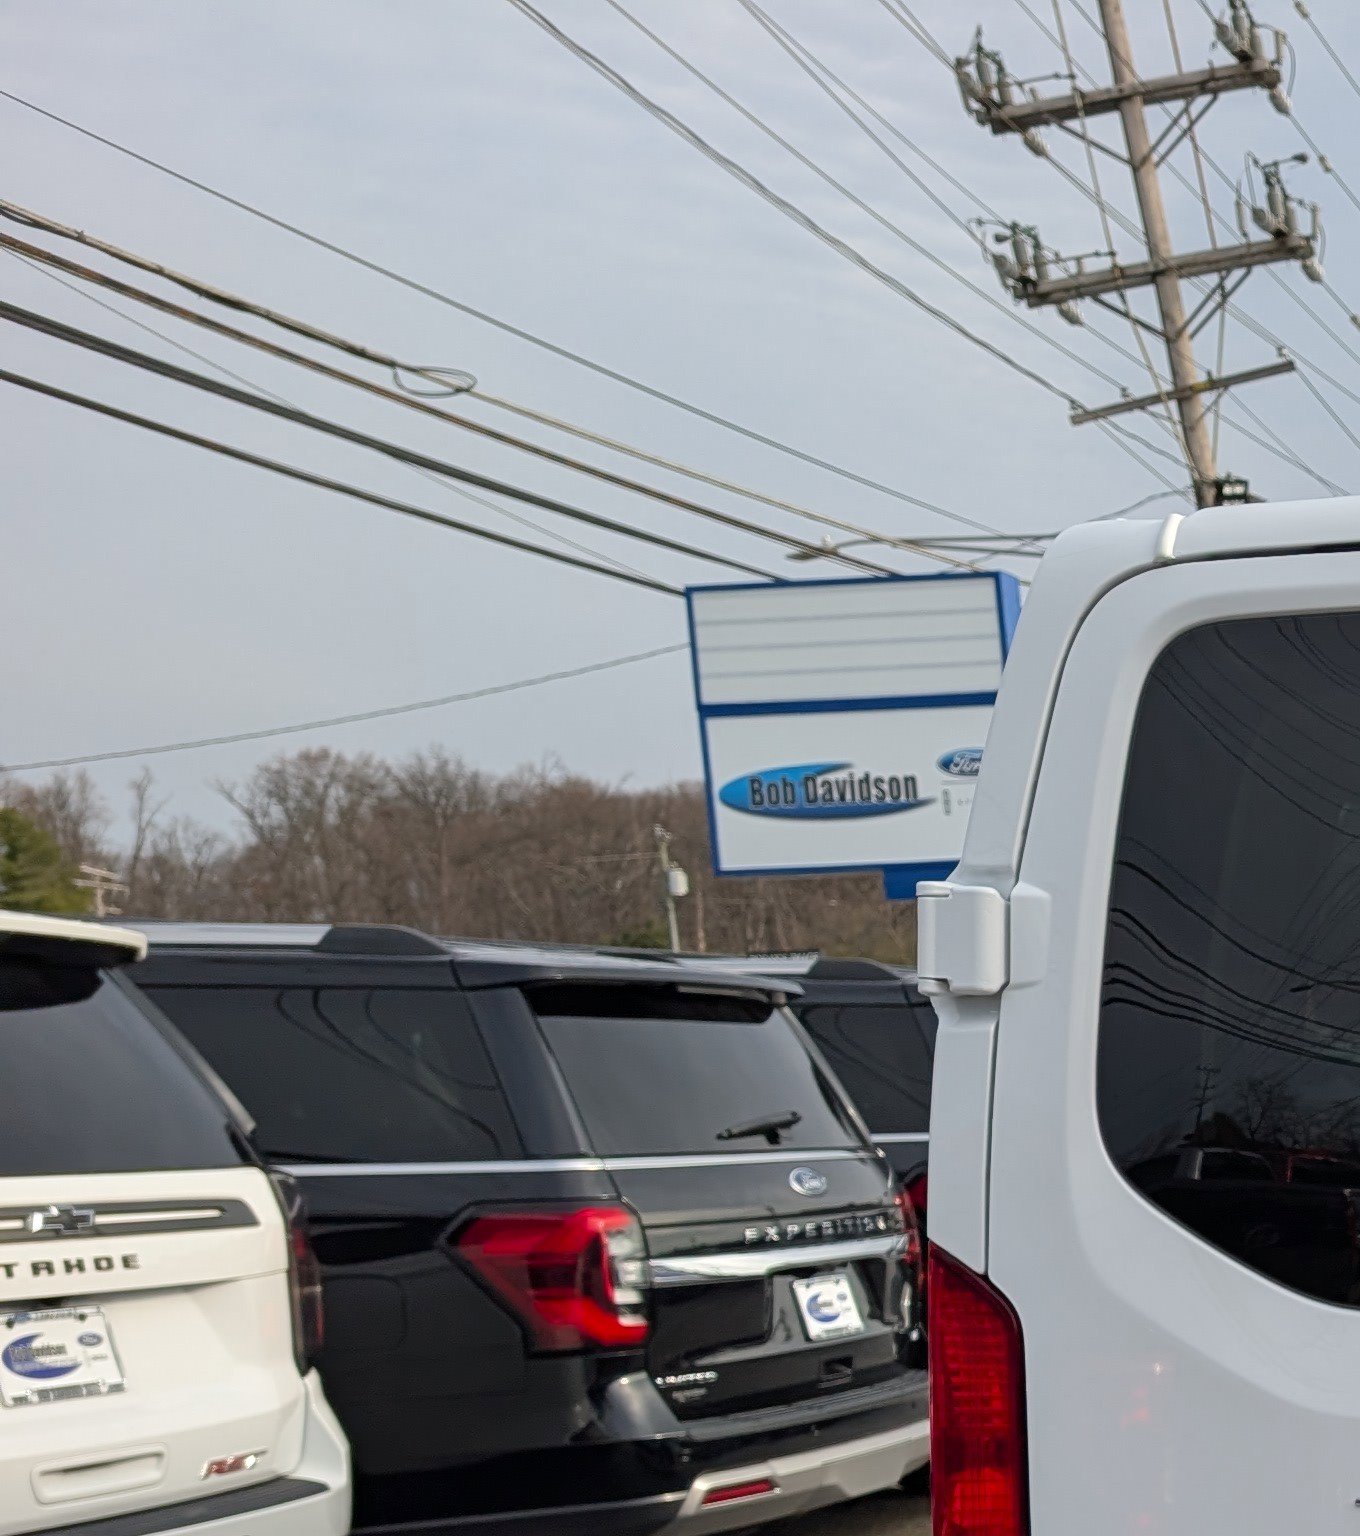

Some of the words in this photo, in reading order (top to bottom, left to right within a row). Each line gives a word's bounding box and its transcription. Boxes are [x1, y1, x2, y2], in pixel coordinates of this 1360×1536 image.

[949, 751, 983, 775] For
[750, 776, 796, 807] Bob
[803, 770, 918, 804] Davidson
[0, 1253, 140, 1278] TAHOE
